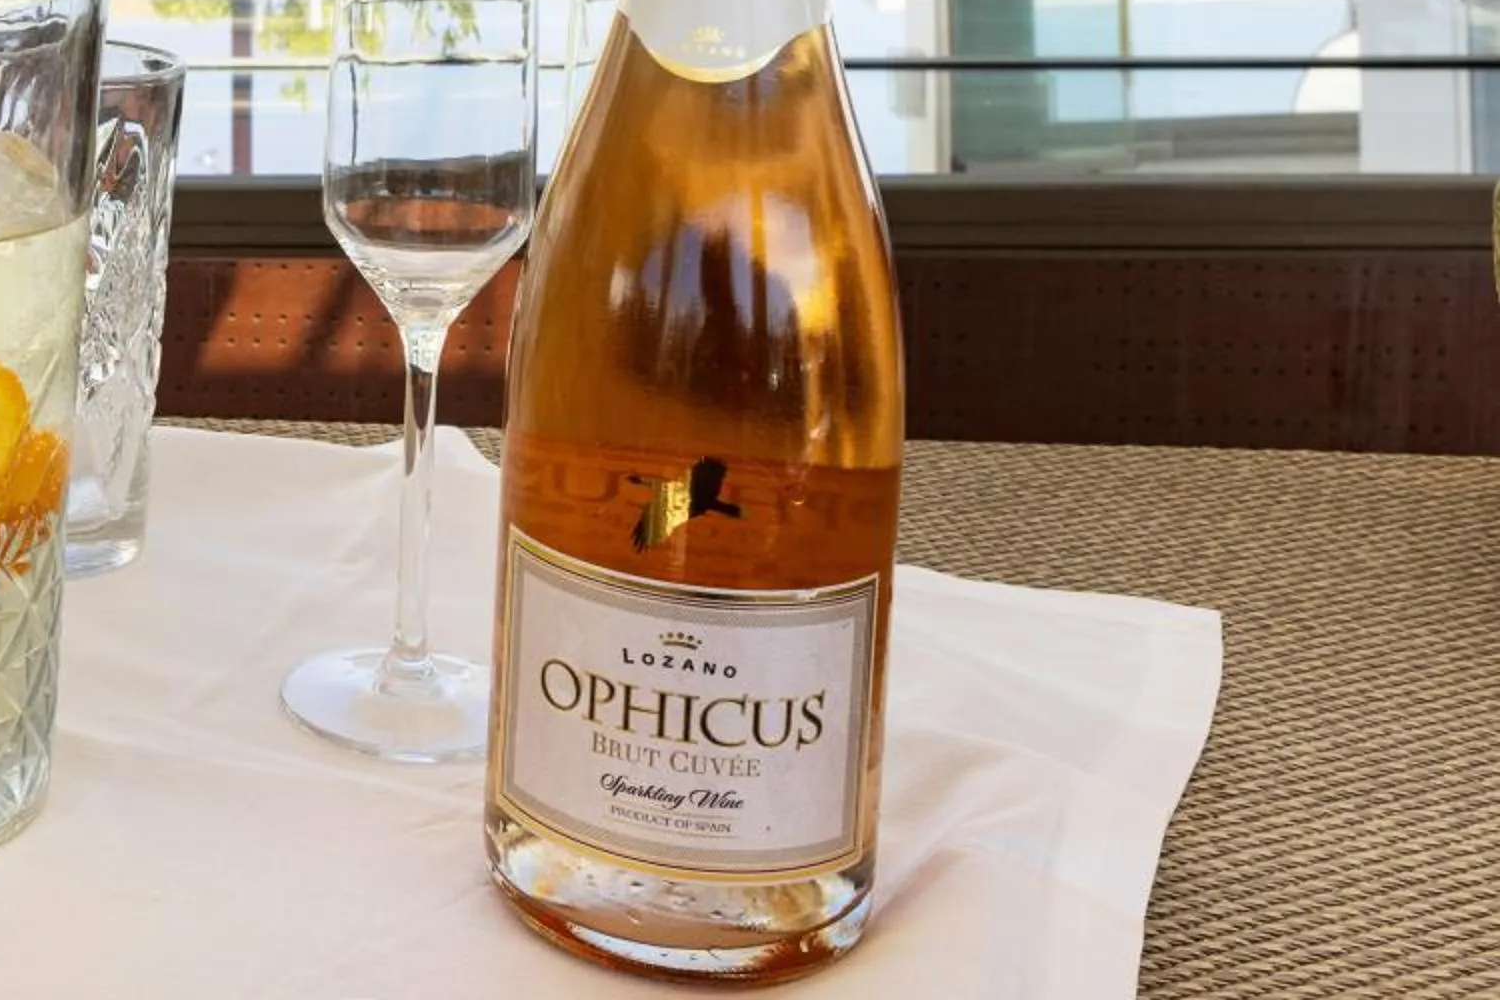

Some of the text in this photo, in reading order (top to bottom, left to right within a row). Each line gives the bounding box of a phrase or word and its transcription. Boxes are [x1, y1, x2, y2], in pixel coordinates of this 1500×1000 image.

[621, 647, 739, 680] LOZANO
[539, 657, 827, 751] OPHICUS
[592, 731, 761, 778] BRUT CUVÉE
[599, 772, 745, 811] Sparkling Wine
[610, 804, 732, 834] PRODUCT OF SPAIN
